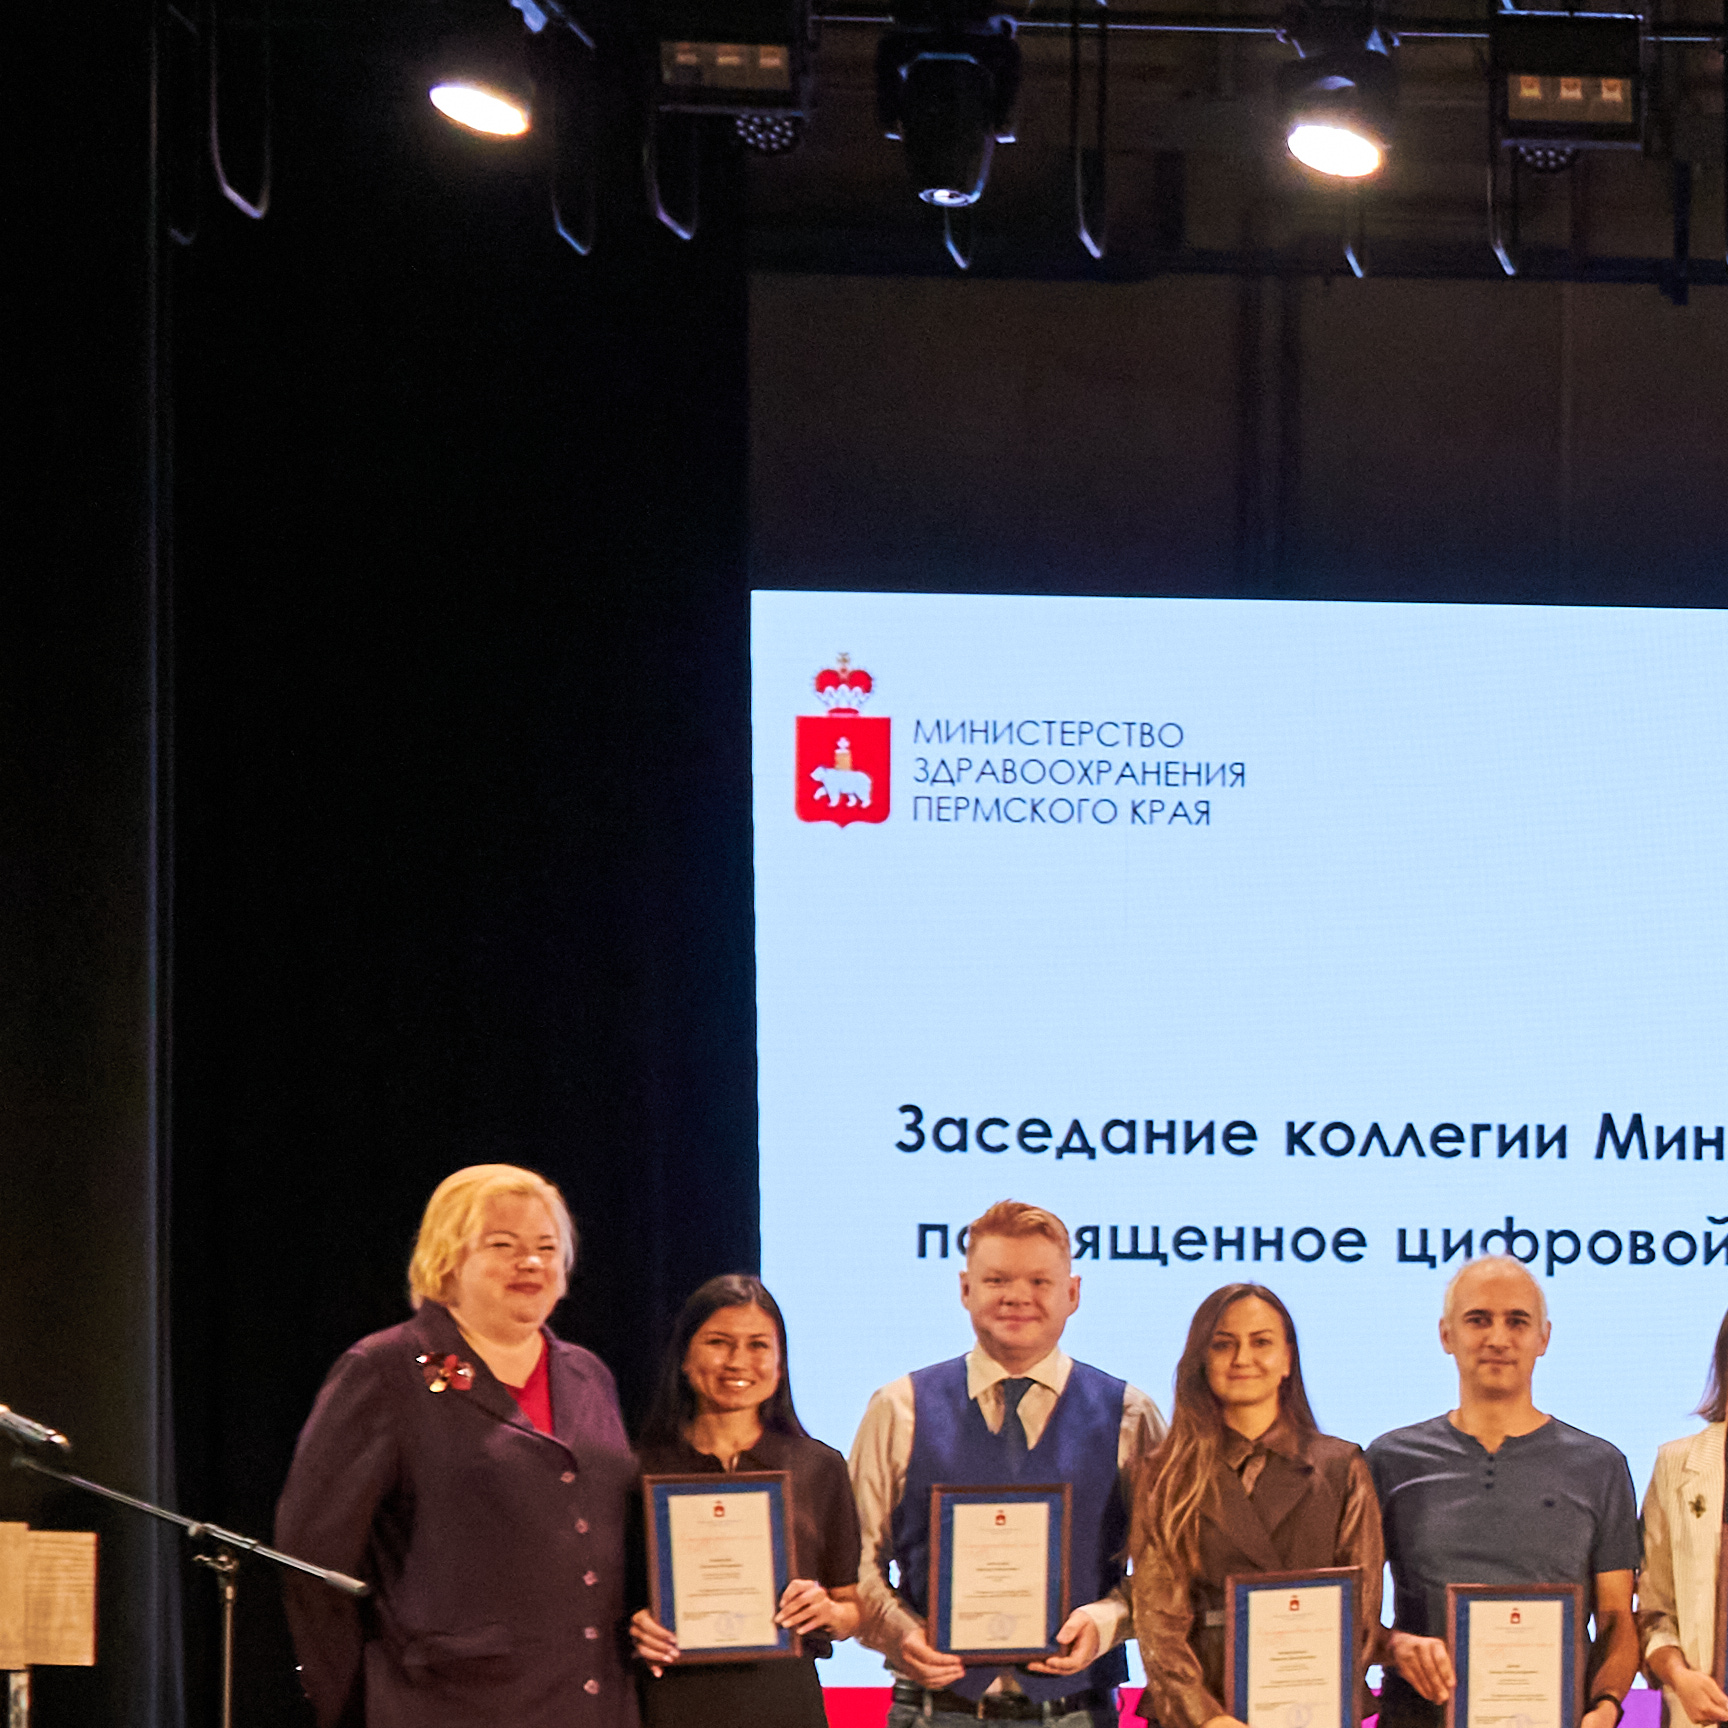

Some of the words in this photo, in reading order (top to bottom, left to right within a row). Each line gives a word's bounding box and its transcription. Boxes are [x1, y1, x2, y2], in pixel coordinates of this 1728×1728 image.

[913, 718, 1184, 749] МИНИСТЕРСТВО
[913, 757, 1246, 788] ЗДРАВООХРАНЕНИЯ
[912, 795, 1118, 825] ПЕРМСКОГО
[1130, 799, 1211, 826] КРАЯ
[894, 1103, 1259, 1160] Заседание
[1285, 1120, 1568, 1160] коллегии
[917, 1222, 1367, 1268] пященное
